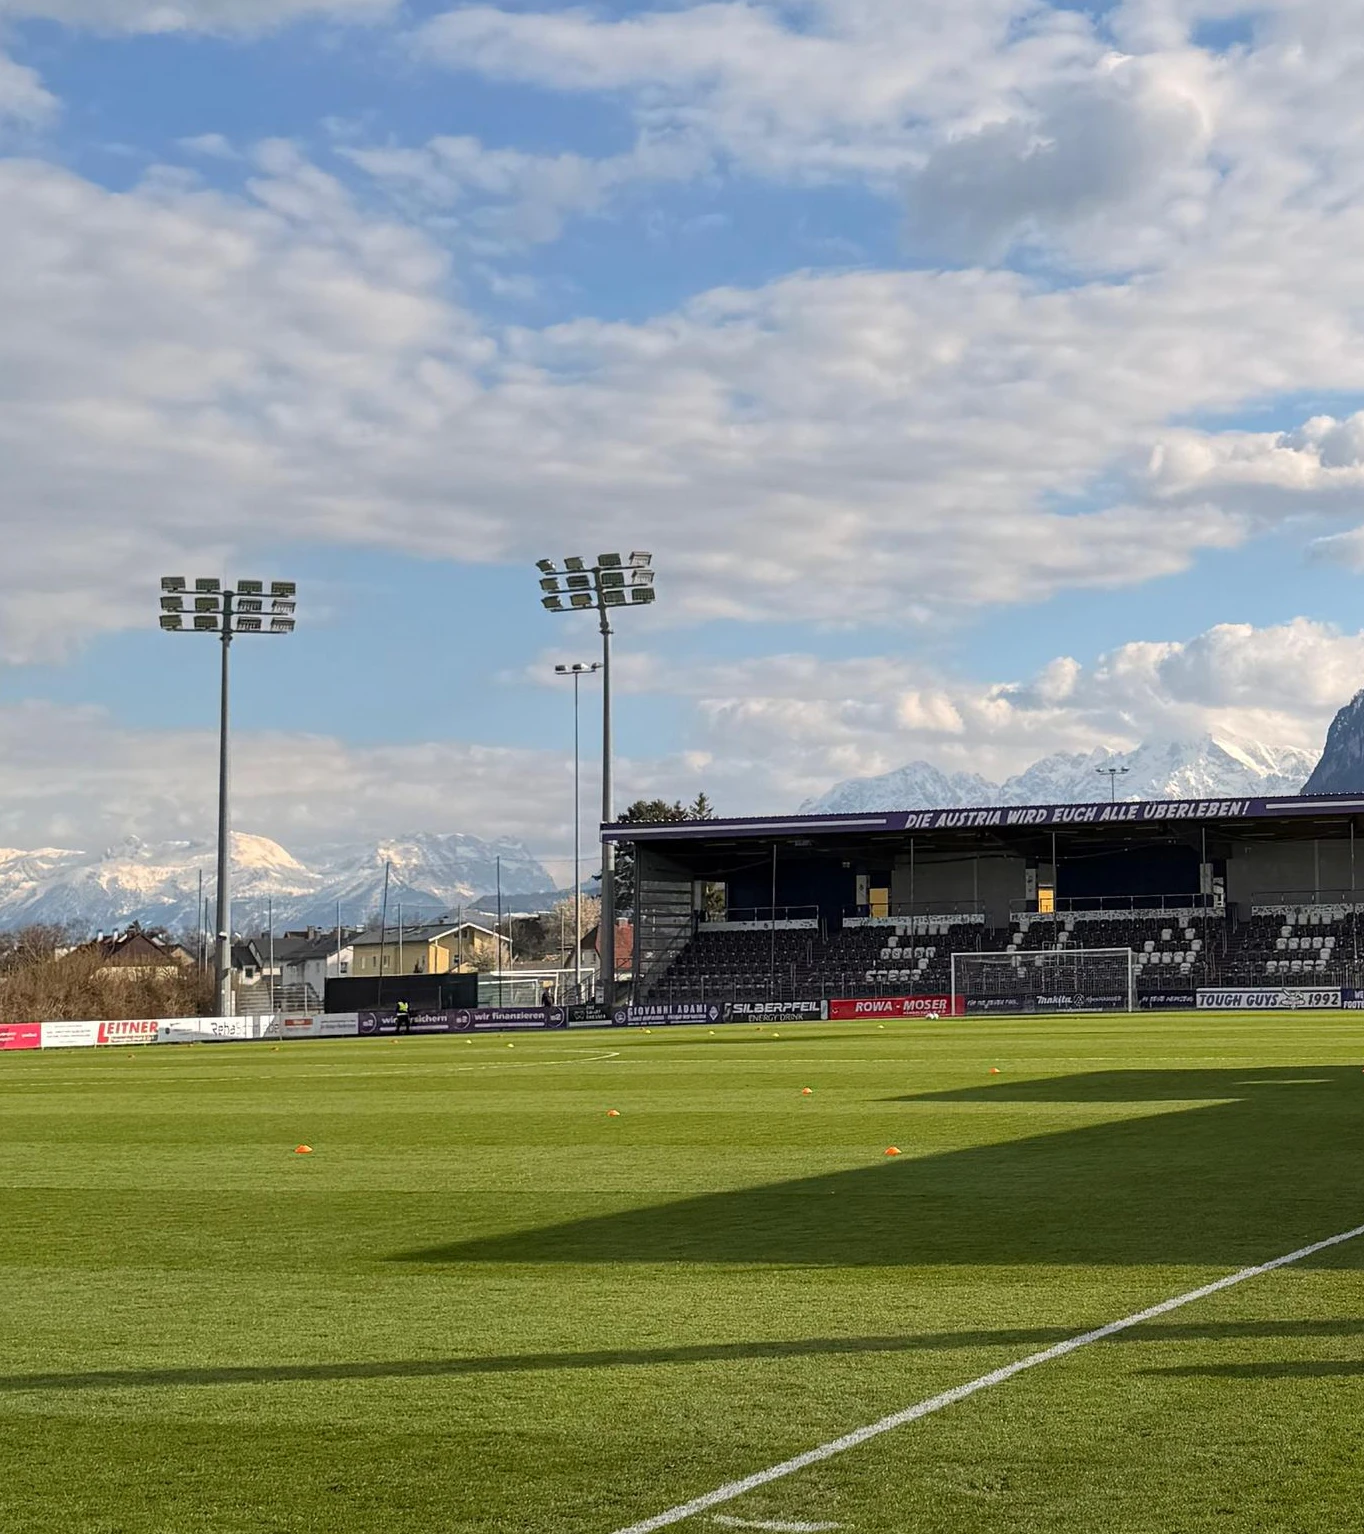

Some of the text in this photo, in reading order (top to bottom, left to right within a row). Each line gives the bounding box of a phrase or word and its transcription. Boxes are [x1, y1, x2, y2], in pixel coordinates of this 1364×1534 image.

[905, 800, 1251, 829] DIE AUSTRIA WIRD EUCH ALLE ÜBERLEBEN!
[1199, 993, 1243, 1007] TOUGH
[1246, 993, 1279, 1007] GUYS
[1308, 992, 1339, 1006] 1992
[1354, 990, 1364, 999] WE
[627, 1003, 708, 1017] GIOVANNI ADAMI
[732, 1001, 821, 1013] SILBERPFEIL
[855, 1000, 892, 1012] ROWA
[903, 999, 948, 1012] MOSER
[474, 1010, 545, 1021] wir finanzieren
[748, 1012, 804, 1022] ENERGY DRINK
[97, 1020, 160, 1044] LEITNER
